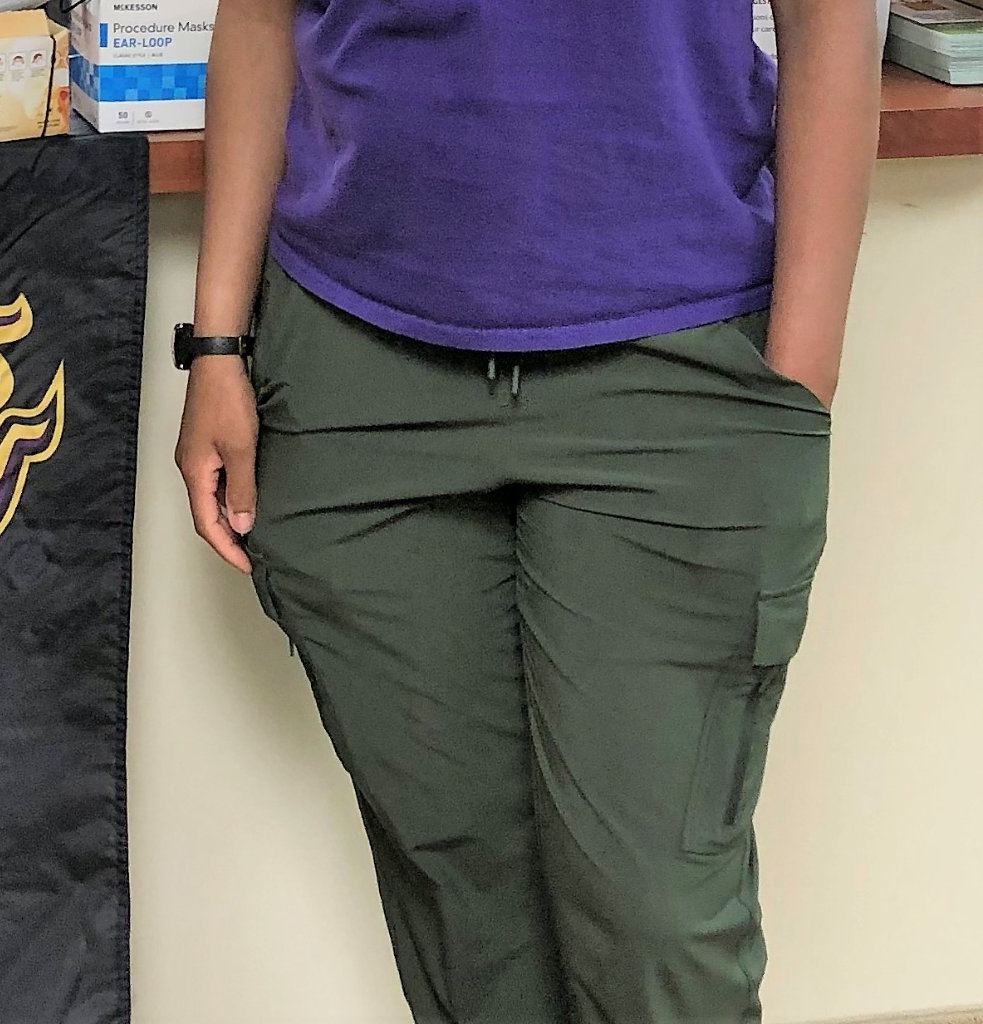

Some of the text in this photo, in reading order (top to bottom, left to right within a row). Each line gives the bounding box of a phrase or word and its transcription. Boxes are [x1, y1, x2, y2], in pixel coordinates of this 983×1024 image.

[113, 21, 215, 33] Procedure Masks
[113, 37, 173, 48] EAR-LOOP
